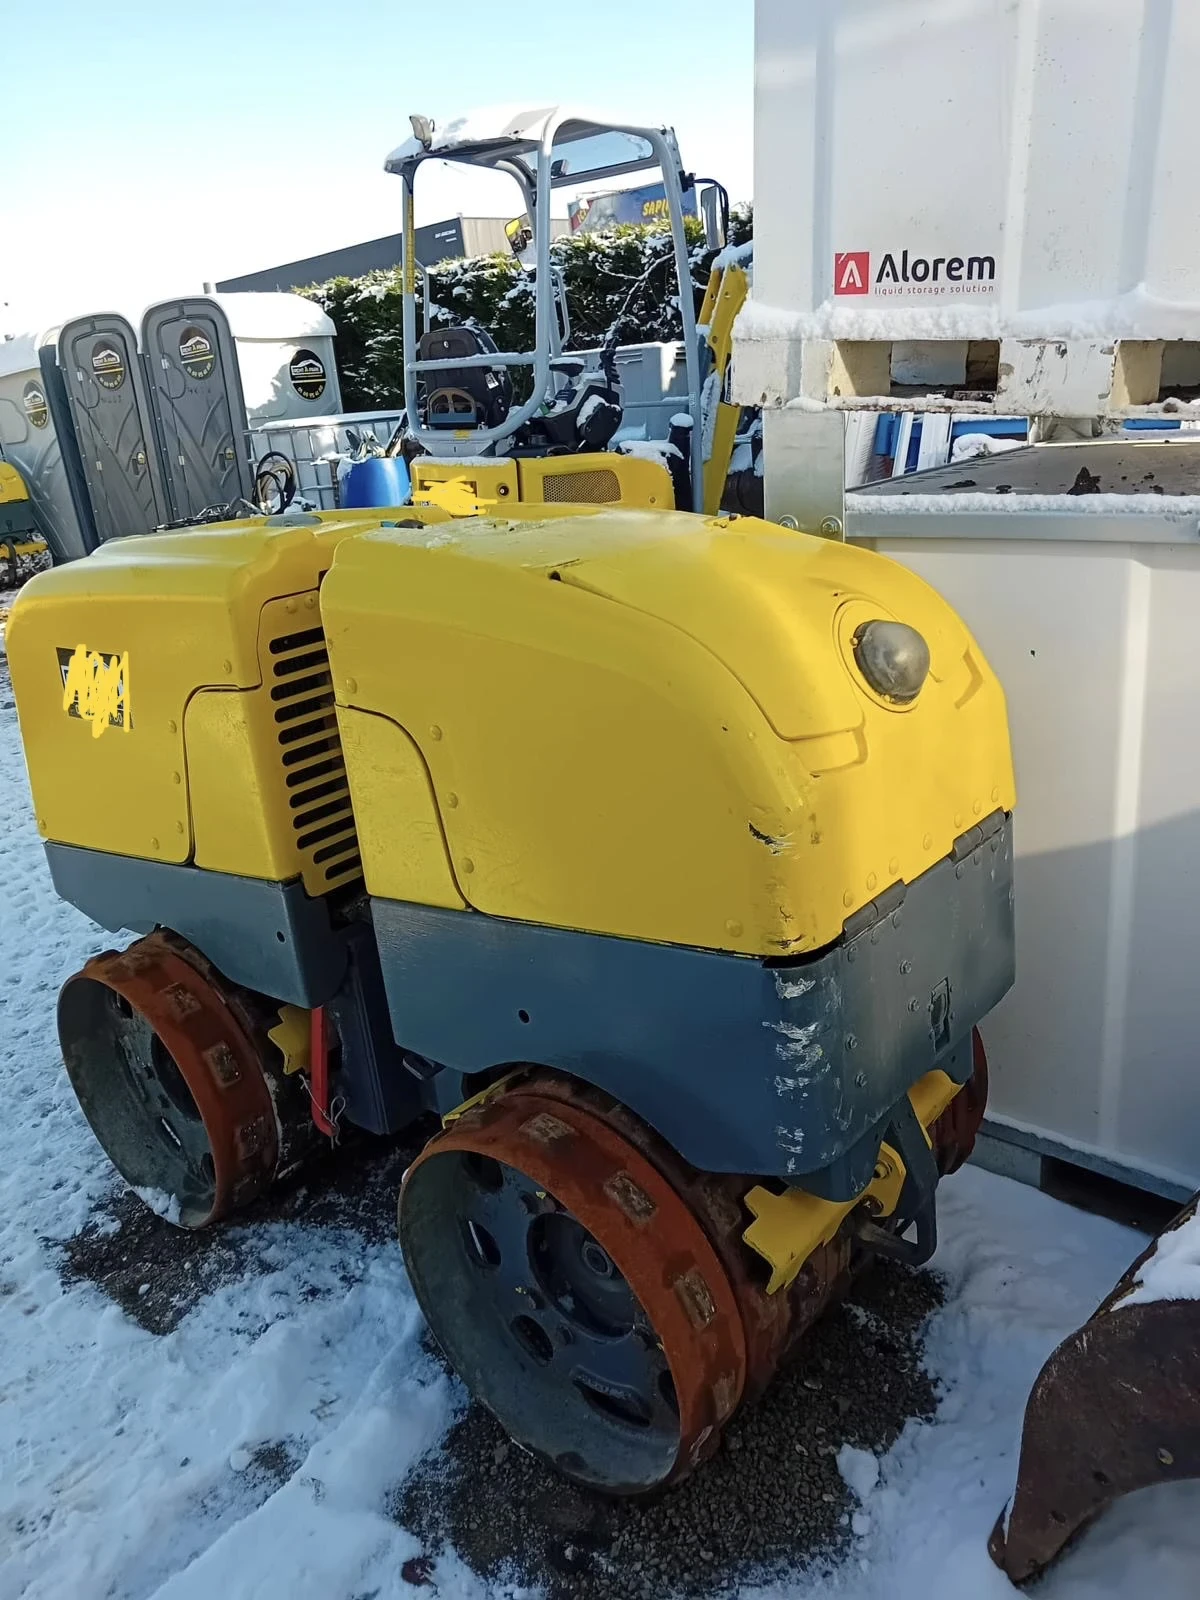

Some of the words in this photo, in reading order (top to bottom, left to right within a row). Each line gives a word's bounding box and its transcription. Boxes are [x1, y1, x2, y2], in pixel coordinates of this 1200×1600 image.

[876, 250, 995, 283] Alorem
[874, 285, 903, 296] liquid
[907, 286, 945, 295] storage
[950, 284, 994, 294] solution
